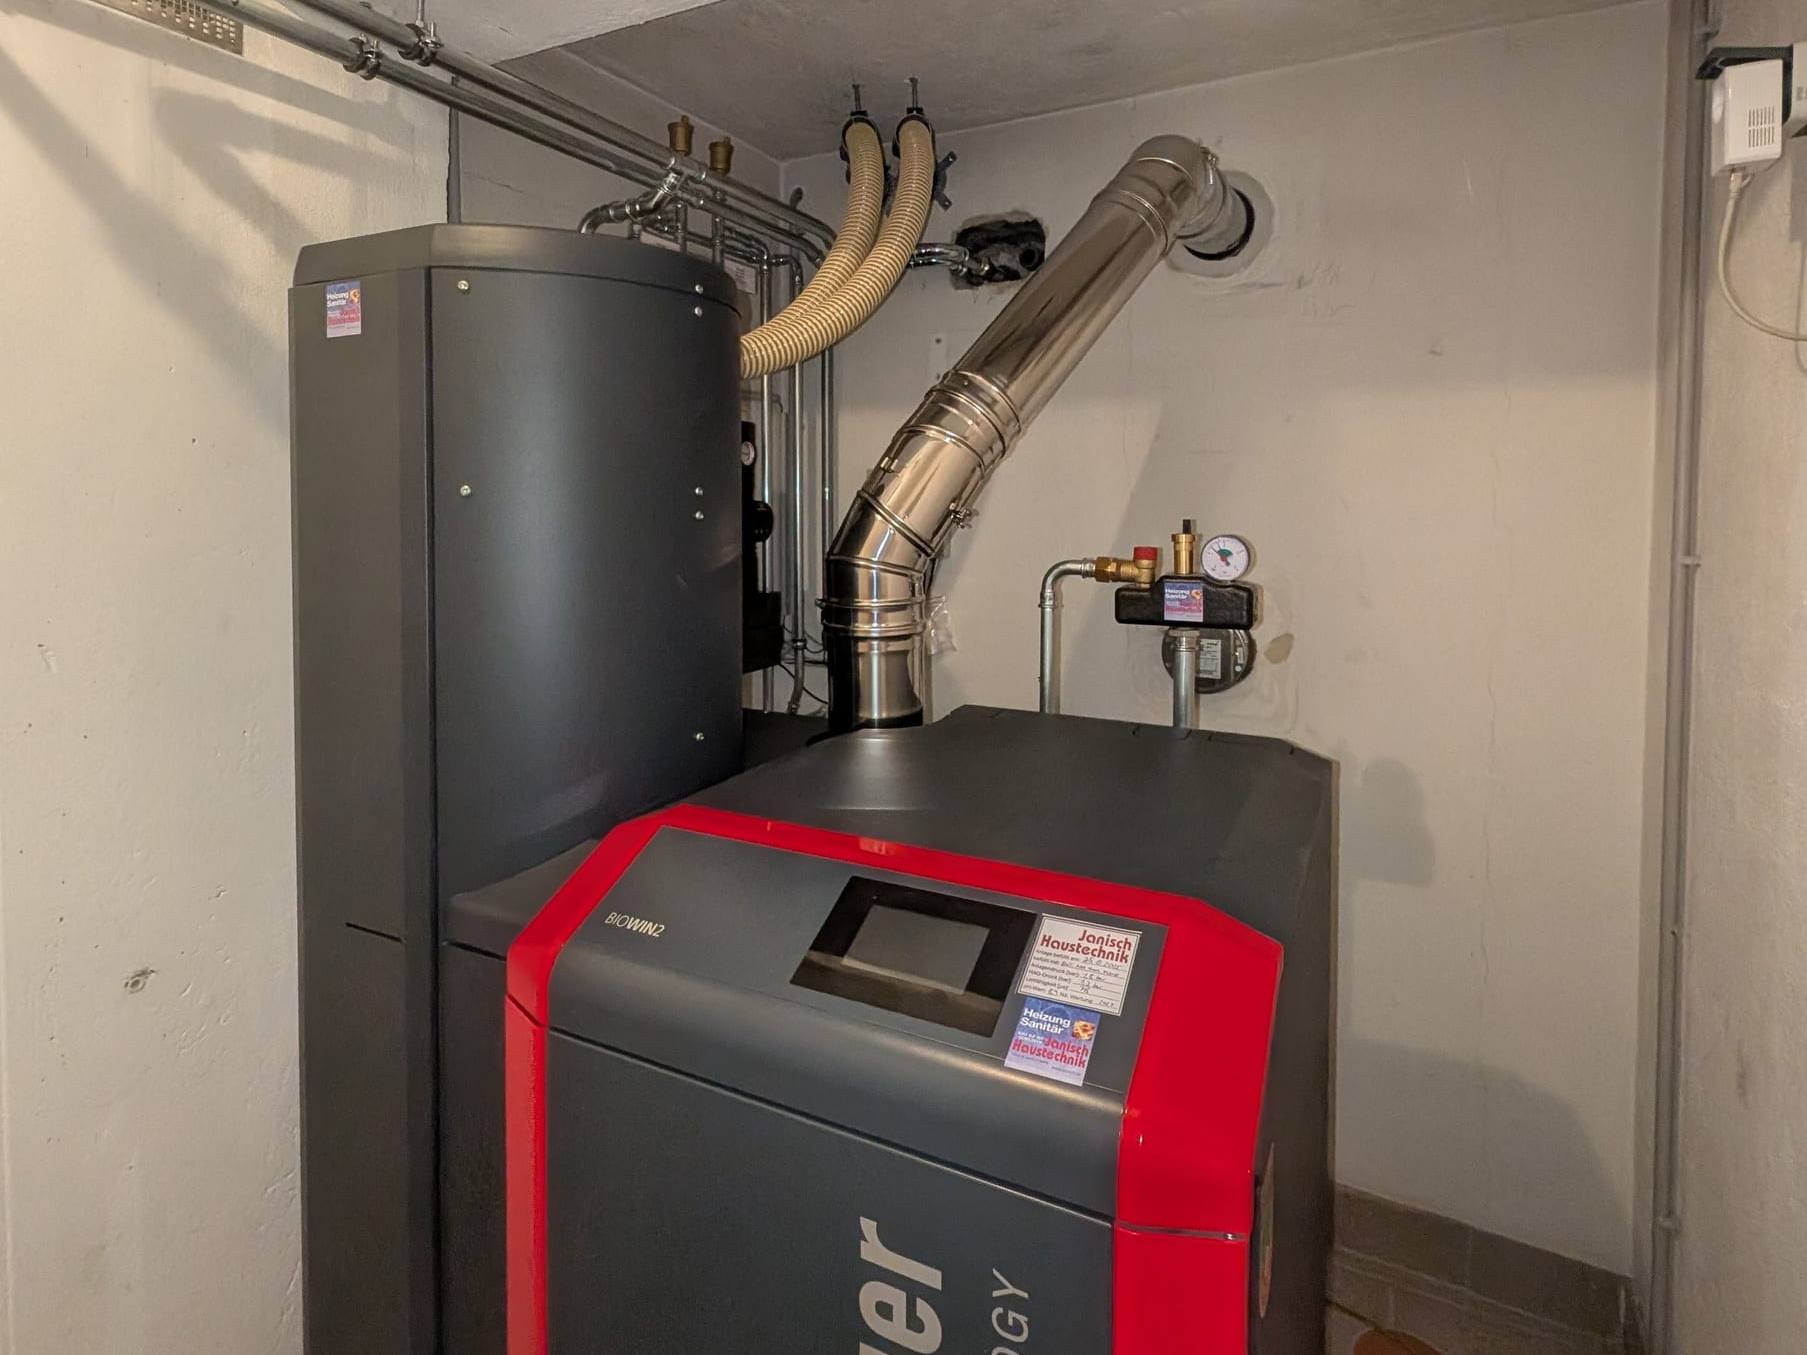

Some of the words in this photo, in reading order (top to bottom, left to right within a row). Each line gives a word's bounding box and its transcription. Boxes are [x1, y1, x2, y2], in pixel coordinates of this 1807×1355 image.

[604, 911, 665, 937] BIOWIN2
[1040, 934, 1129, 963] Haustechnik
[1079, 930, 1132, 951] Janisch
[1020, 1017, 1065, 1034] Sanitär
[1023, 1007, 1071, 1028] Heizung
[1011, 1039, 1087, 1069] Haustechnik
[1043, 1036, 1089, 1057] Janisch
[859, 1216, 942, 1355] er
[991, 1267, 1029, 1355] GY
